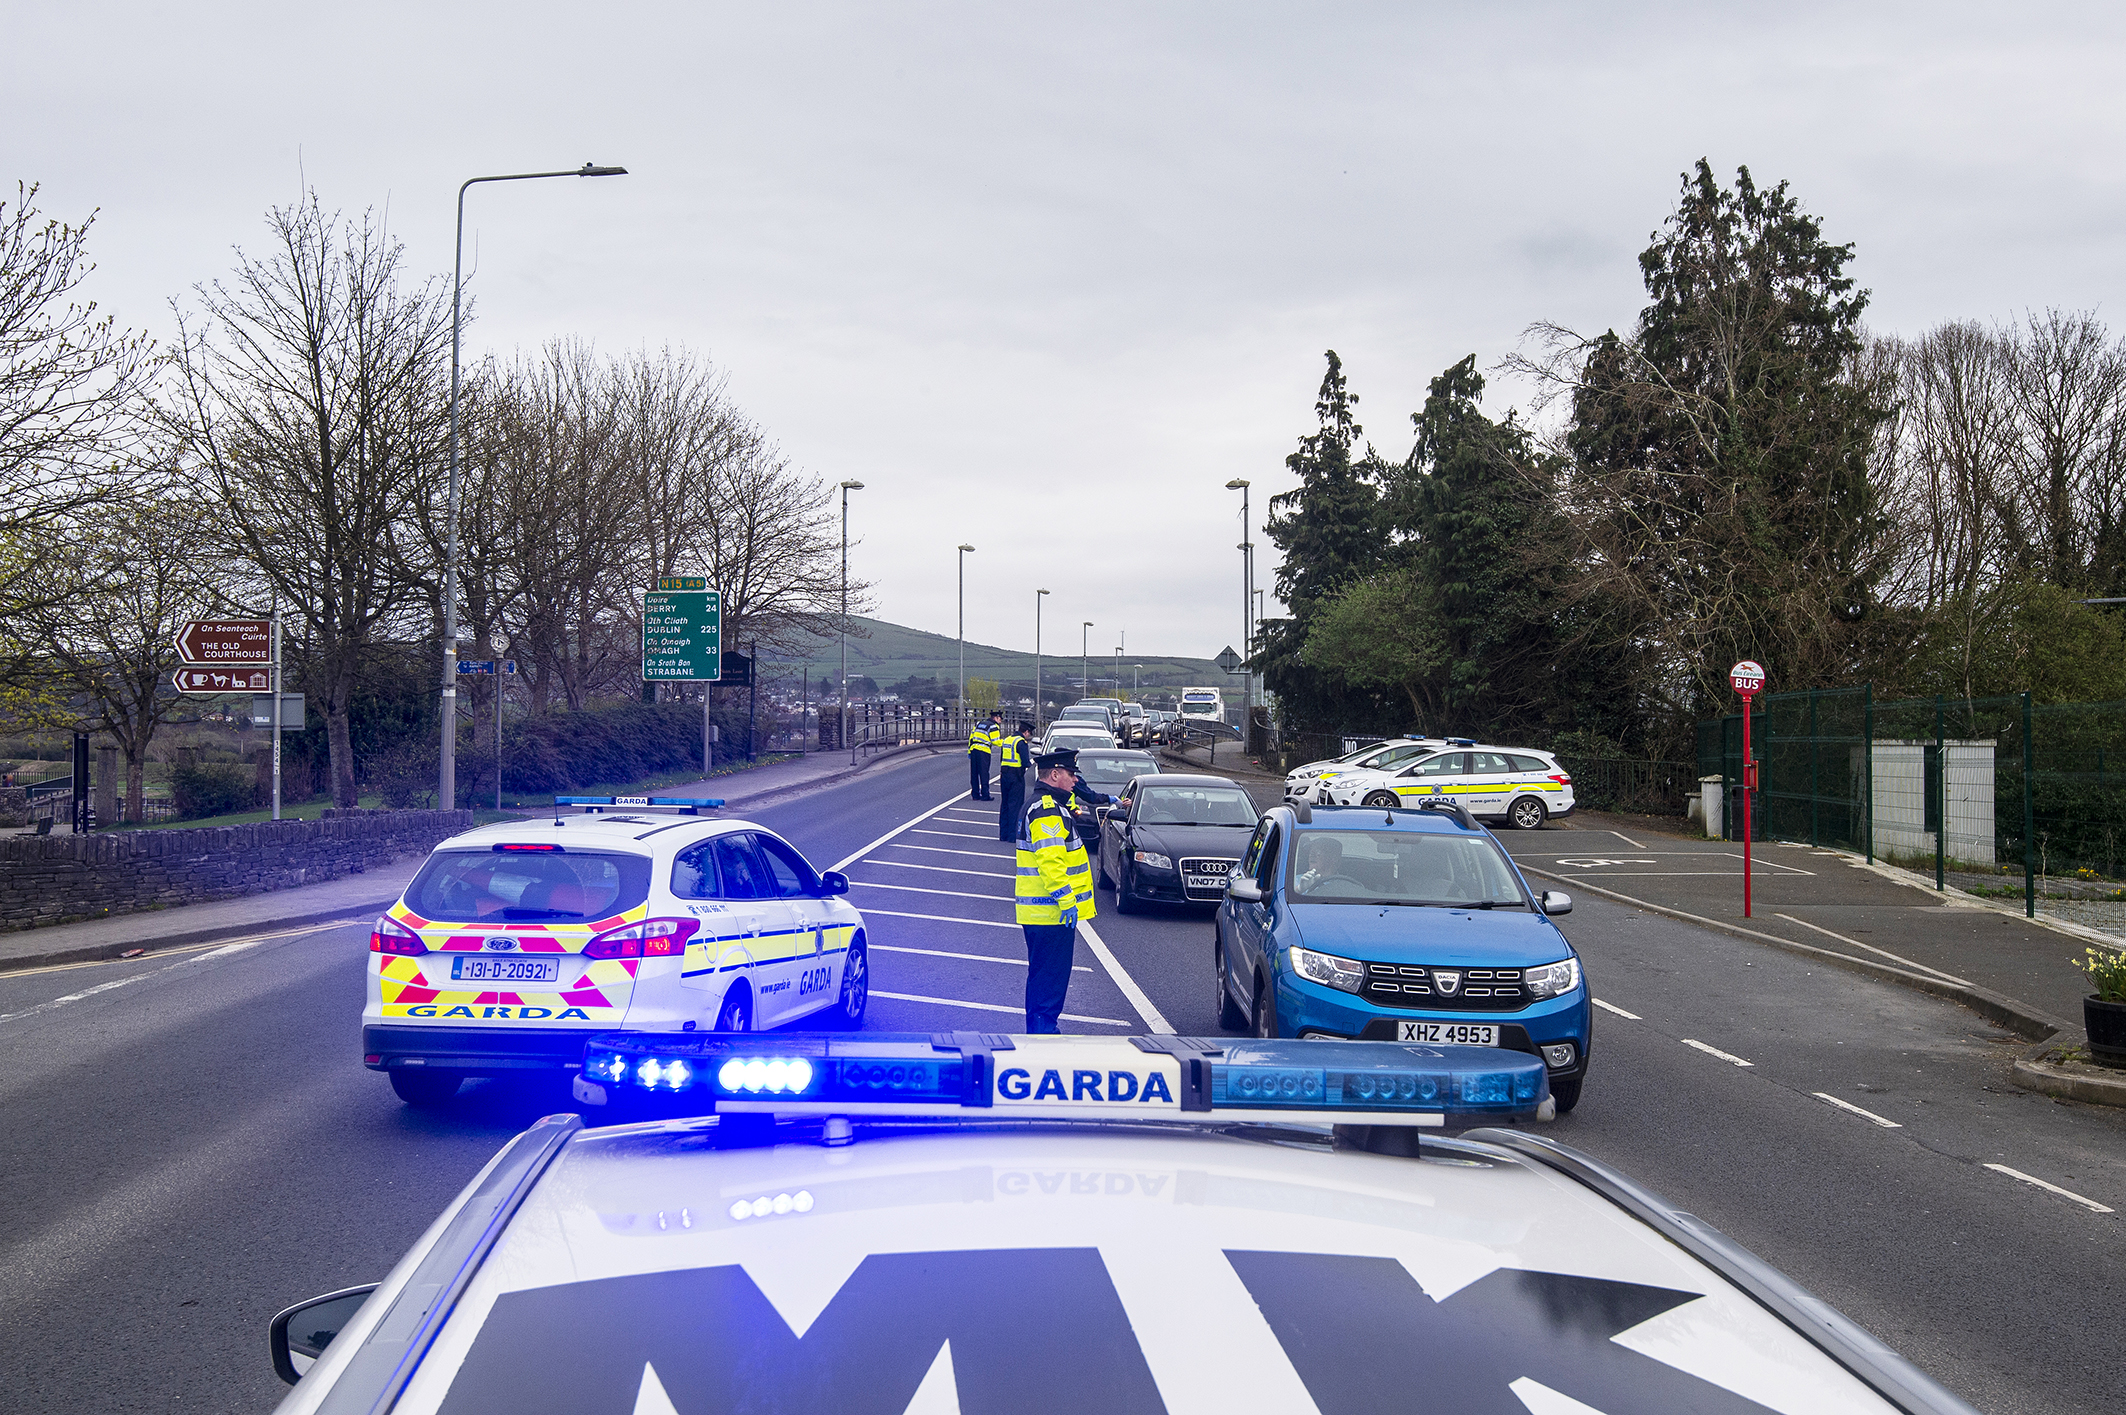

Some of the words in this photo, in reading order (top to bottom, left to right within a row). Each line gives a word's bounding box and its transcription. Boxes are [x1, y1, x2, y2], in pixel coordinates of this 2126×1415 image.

[661, 579, 682, 588] N15
[1735, 678, 1759, 690] BUS
[1345, 741, 1357, 753] NO
[470, 962, 547, 979] 131-D-20921
[800, 966, 831, 995] GARDA
[406, 1005, 591, 1020] GARDA
[1404, 1023, 1440, 1042] XHZ
[1445, 1026, 1492, 1044] 4953
[997, 1068, 1173, 1103] GARDA
